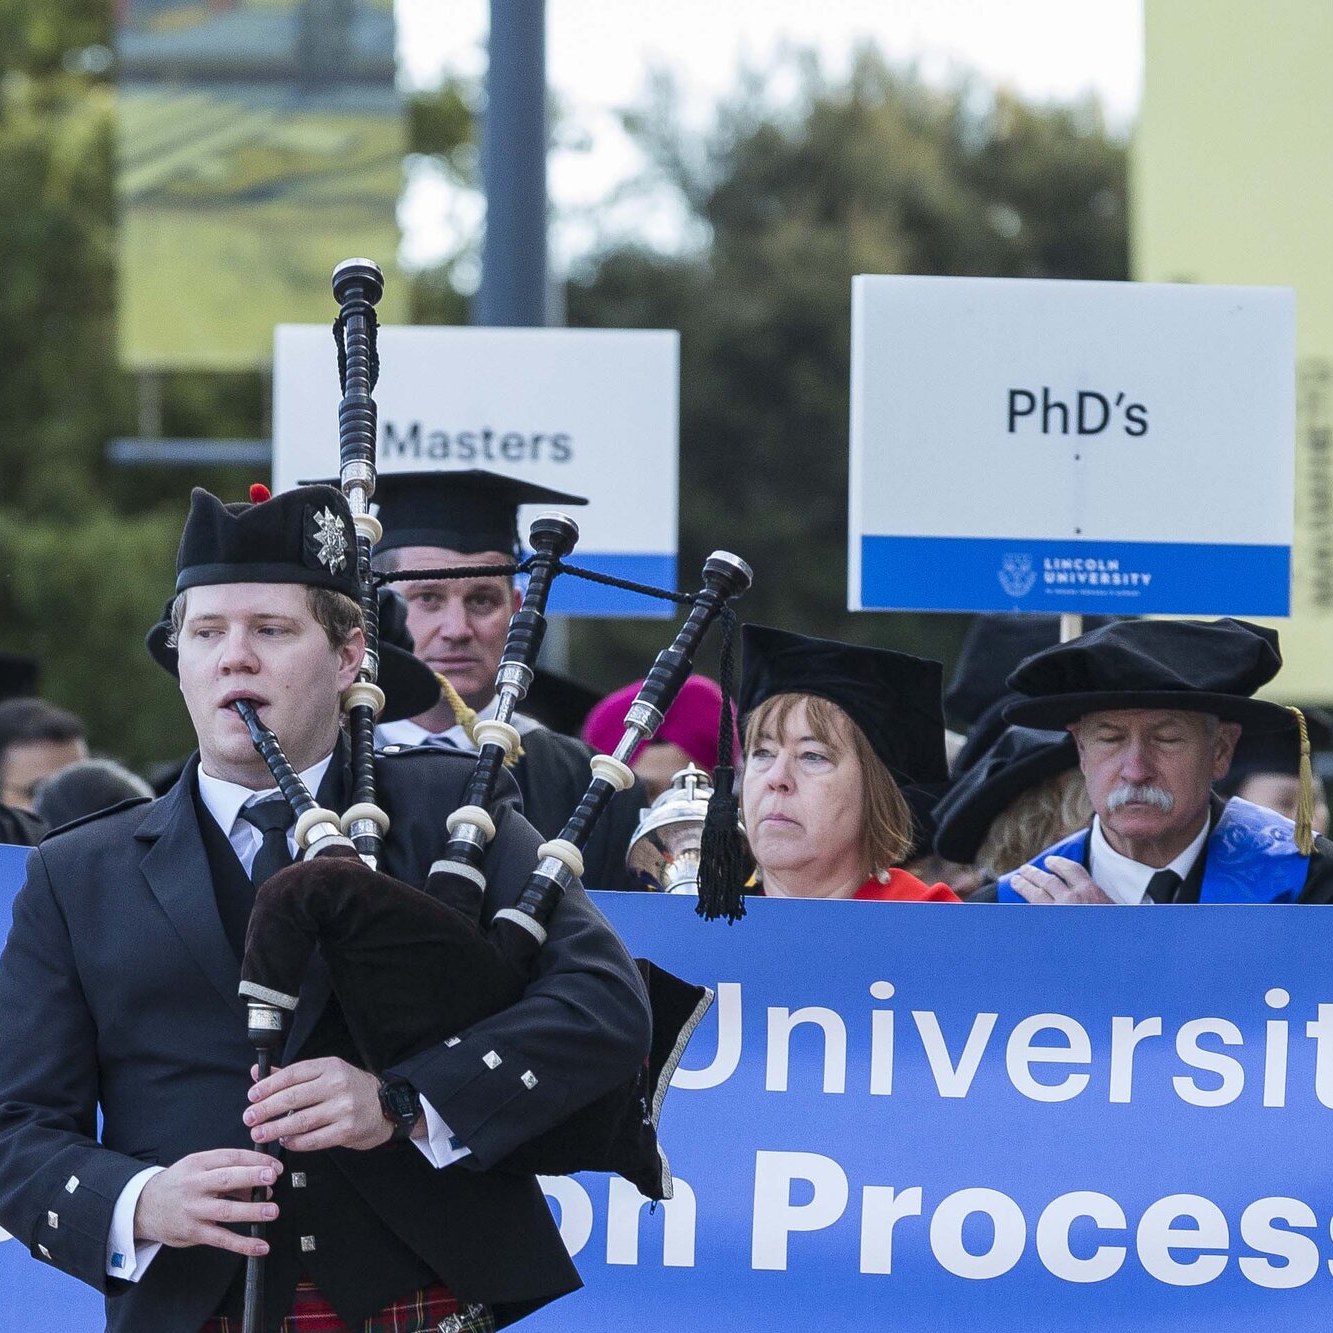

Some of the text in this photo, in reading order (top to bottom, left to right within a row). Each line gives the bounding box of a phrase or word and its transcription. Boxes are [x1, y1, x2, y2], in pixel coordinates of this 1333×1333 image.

[1008, 387, 1148, 436] PhD's
[382, 420, 573, 463] Masters
[1043, 558, 1119, 571] LINCOLN
[1043, 571, 1152, 586] UNIVERSITY
